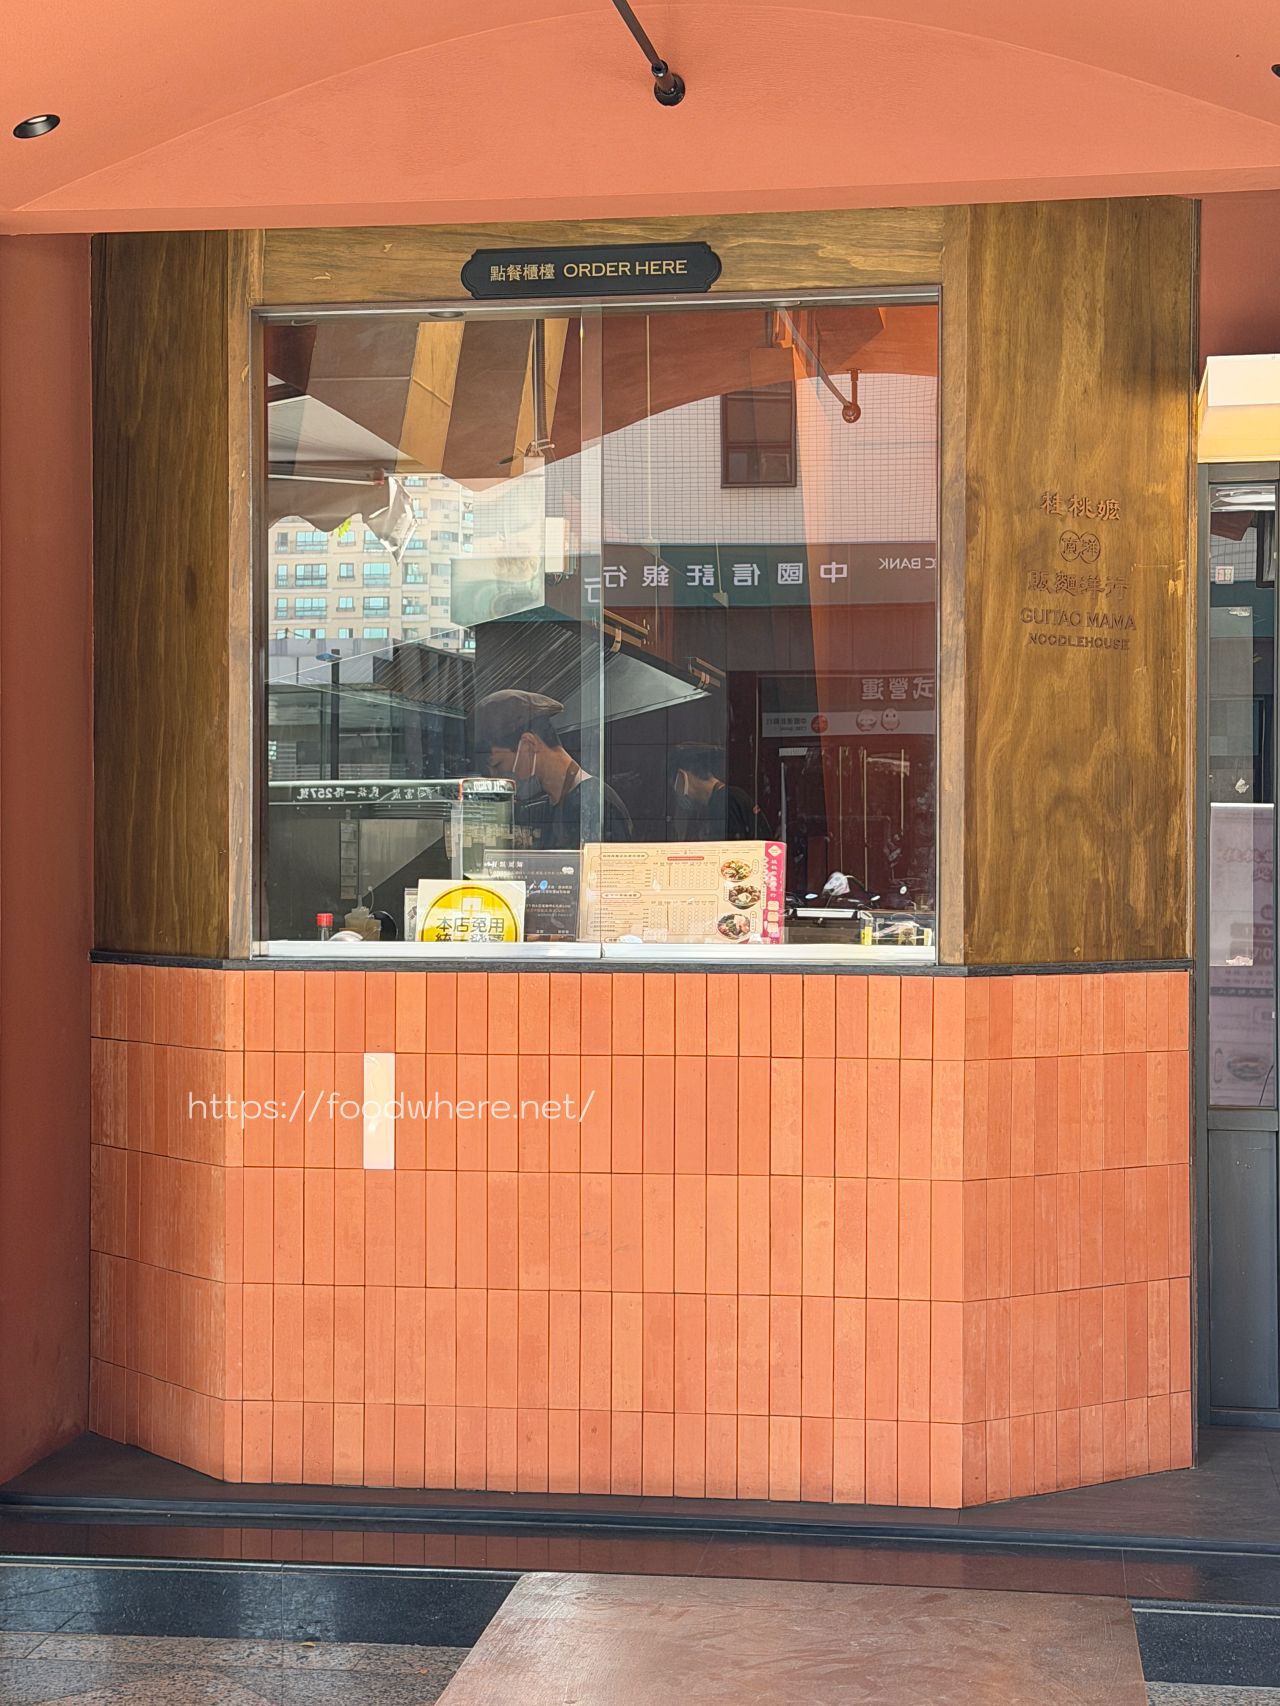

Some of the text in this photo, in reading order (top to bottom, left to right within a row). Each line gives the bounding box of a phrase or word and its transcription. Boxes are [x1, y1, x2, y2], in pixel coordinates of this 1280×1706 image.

[490, 259, 688, 282] 點餐櫃檯 ORDER HERE
[1020, 607, 1137, 631] GUITAO MAMA
[1029, 632, 1130, 651] NOODLEHOUSE
[436, 916, 505, 933] 本店免用
